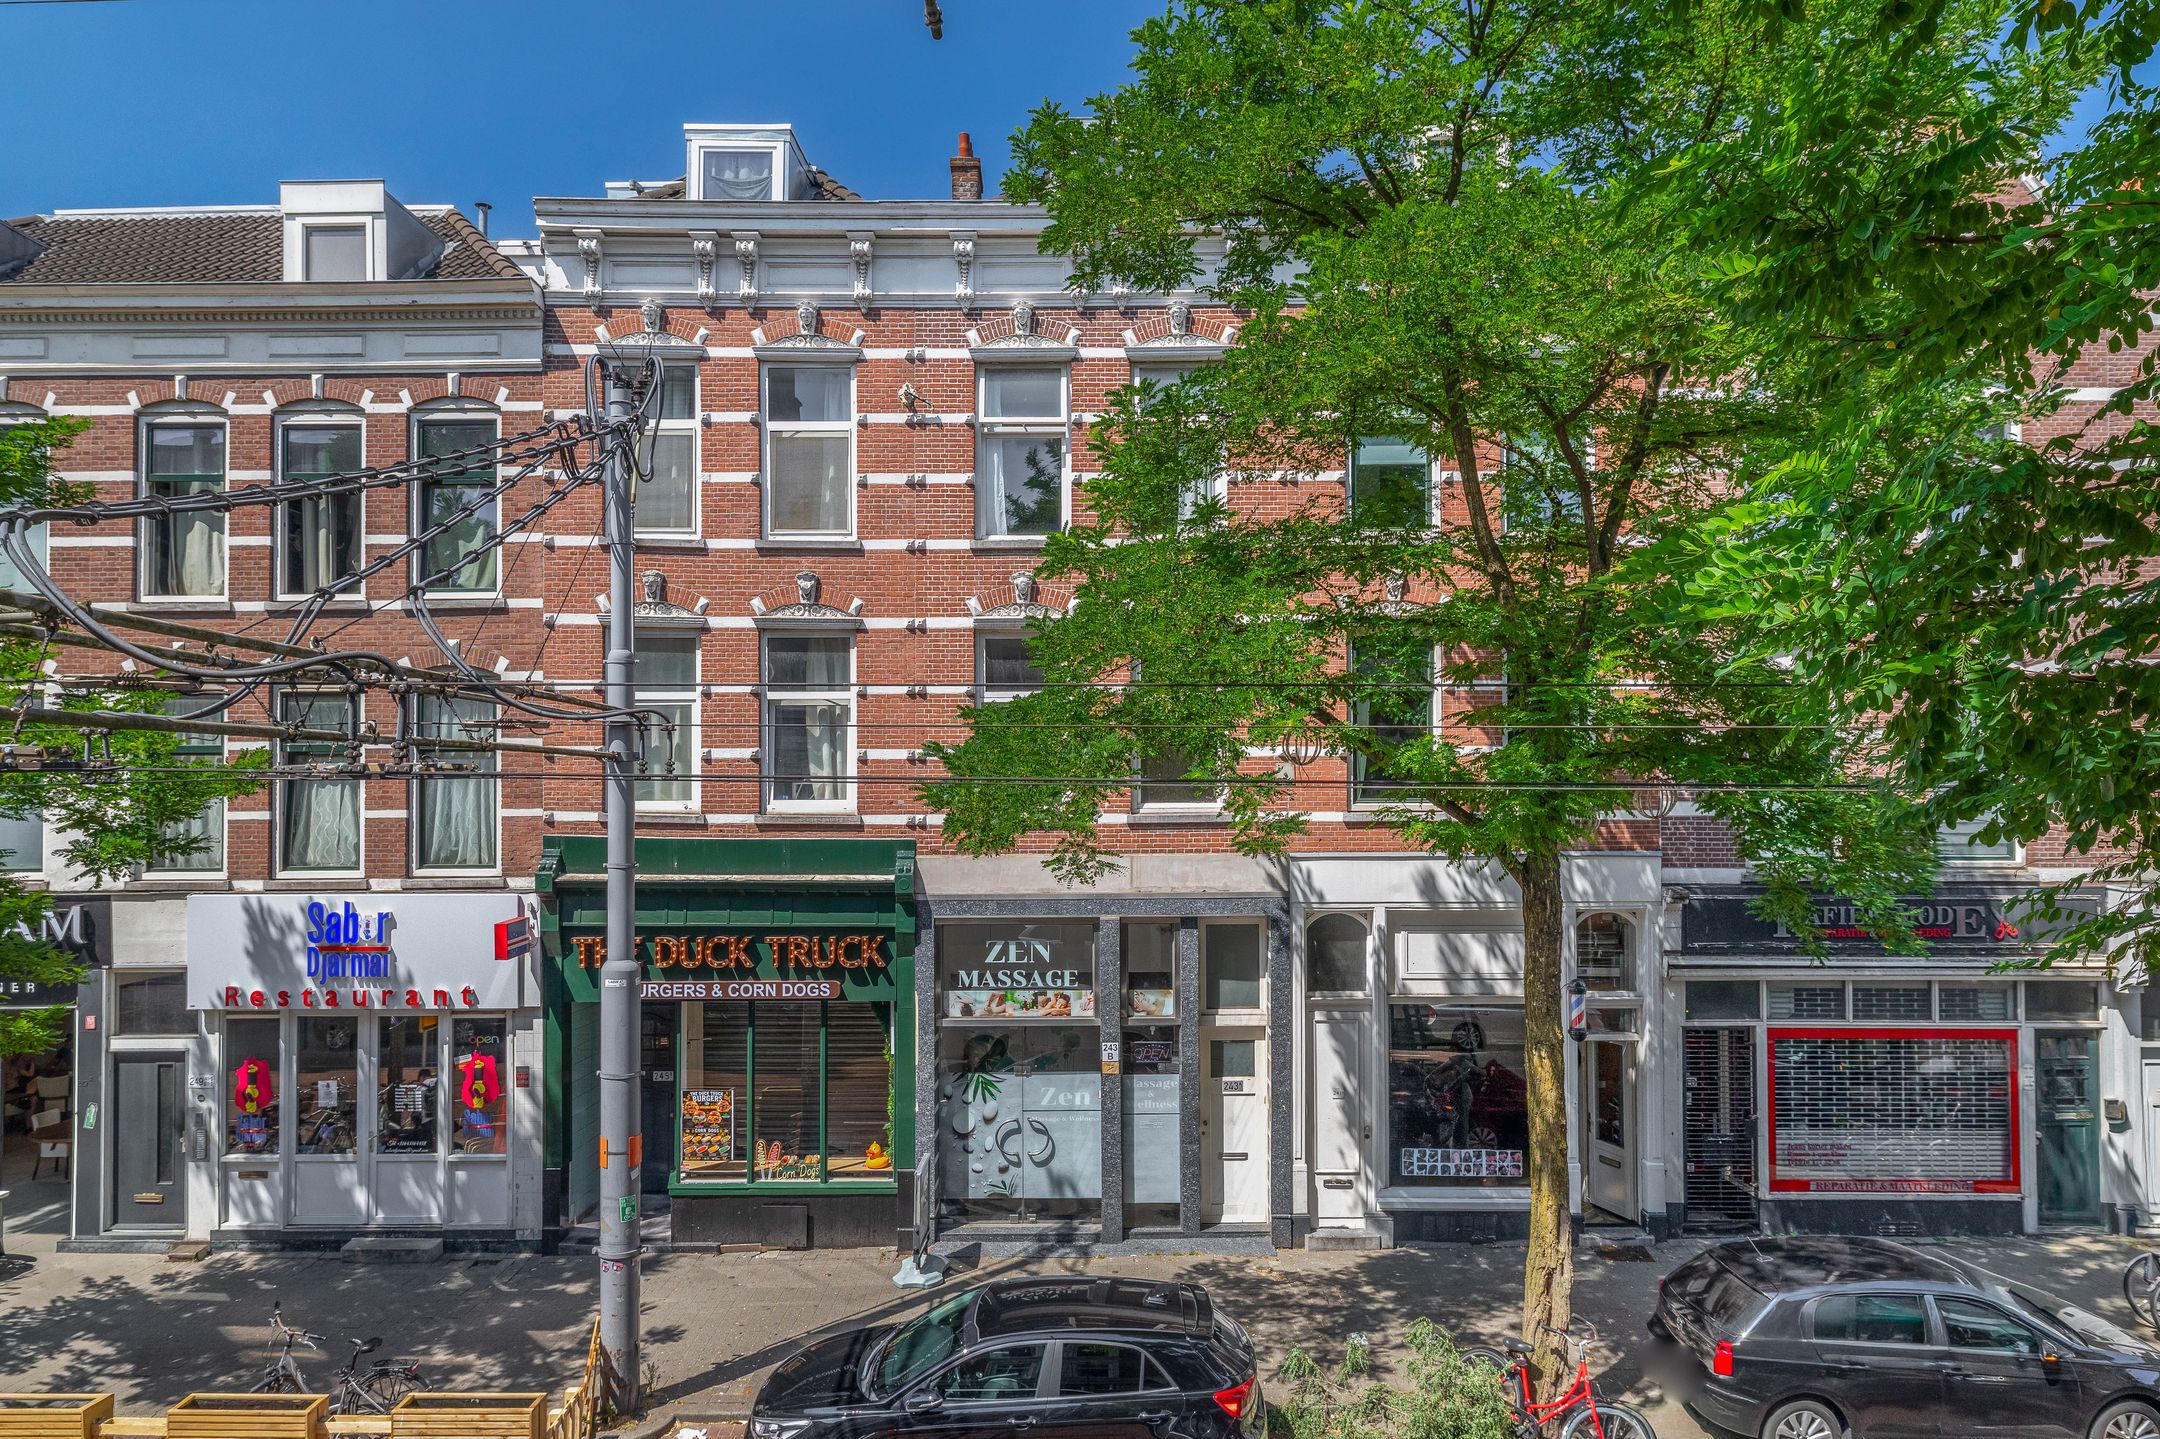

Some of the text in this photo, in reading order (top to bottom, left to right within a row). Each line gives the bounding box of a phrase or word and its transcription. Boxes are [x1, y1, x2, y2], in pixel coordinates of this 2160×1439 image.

[571, 936, 886, 968] TH DUCK TRUCK
[984, 940, 1050, 964] ZEN
[306, 946, 390, 985] Djarmai
[957, 969, 1079, 988] MASSAGE
[225, 985, 479, 1007] Restaurant
[711, 984, 722, 997] &
[727, 983, 776, 998] CORN
[782, 983, 831, 998] DOGS
[470, 1035, 500, 1047] open
[1103, 1043, 1118, 1052] 243
[1107, 1053, 1114, 1061] B
[1134, 1048, 1170, 1060] OPEN
[1040, 1087, 1090, 1106] Zen
[1147, 1090, 1155, 1098] &
[777, 1164, 819, 1179] Corn Dogs
[1815, 1180, 1876, 1191] REPARATIE
[1879, 1181, 1887, 1191] &
